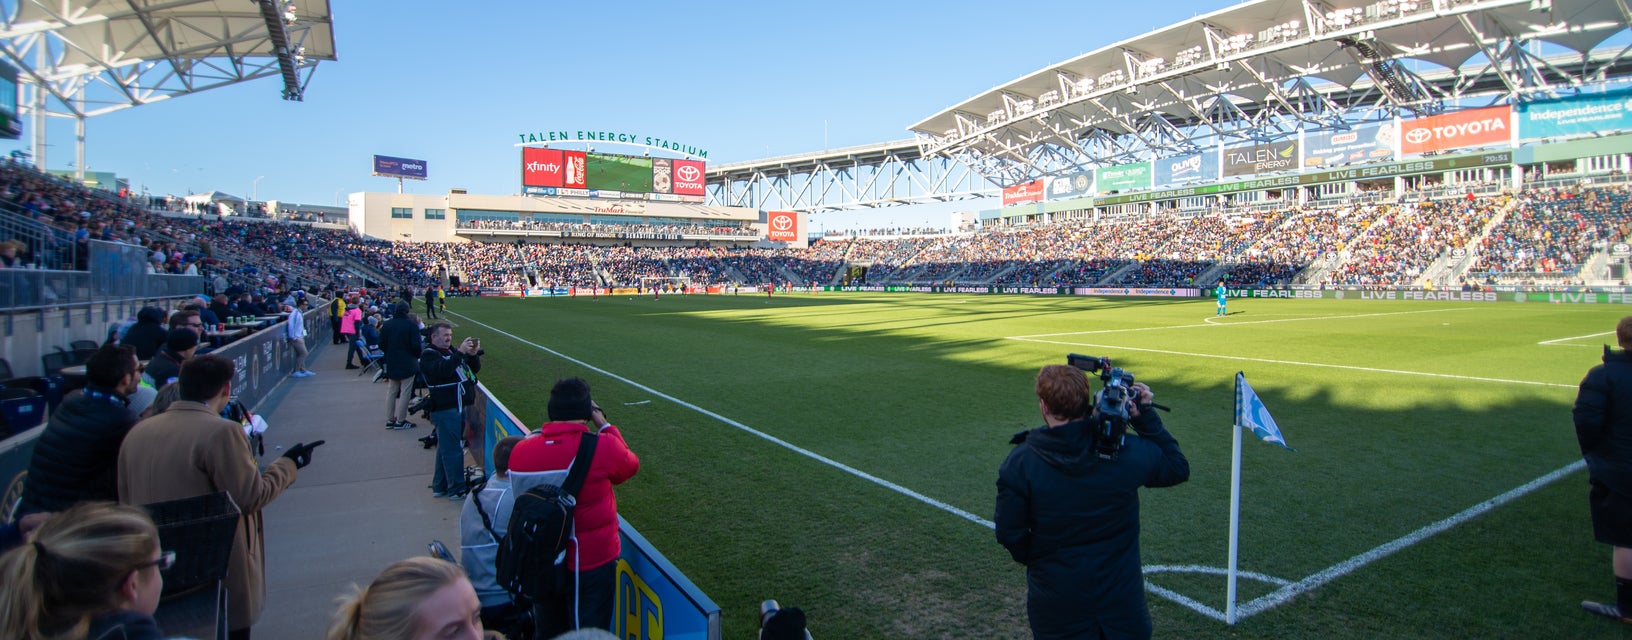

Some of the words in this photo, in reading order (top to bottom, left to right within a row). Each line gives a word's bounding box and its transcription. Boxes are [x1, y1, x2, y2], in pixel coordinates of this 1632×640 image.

[1529, 101, 1623, 121] Independence
[1433, 117, 1505, 140] TOYOTA
[519, 131, 568, 144] TALEN
[577, 131, 637, 144] ENERGY
[645, 136, 709, 159] STADIUM
[1227, 148, 1277, 165] TALEN
[1484, 153, 1509, 163] 70:51
[402, 162, 423, 171] metro
[526, 161, 561, 175] xfinity
[1256, 159, 1292, 171] ENERGY
[1328, 169, 1357, 180] LIVE
[1362, 161, 1435, 177] FEARLESS
[674, 181, 703, 190] TOYOTA
[1217, 183, 1240, 192] LIVE
[1243, 176, 1300, 188] FEARLESS
[1129, 193, 1147, 202] LIVE
[1150, 188, 1195, 199] FEARLESS
[594, 206, 625, 214] TruMark
[771, 230, 795, 238] TOYOTA
[1253, 289, 1322, 298] FEARLESS
[1361, 290, 1396, 299] LIVE
[1403, 291, 1497, 301] FEARLESS
[1549, 293, 1597, 303] LIVE
